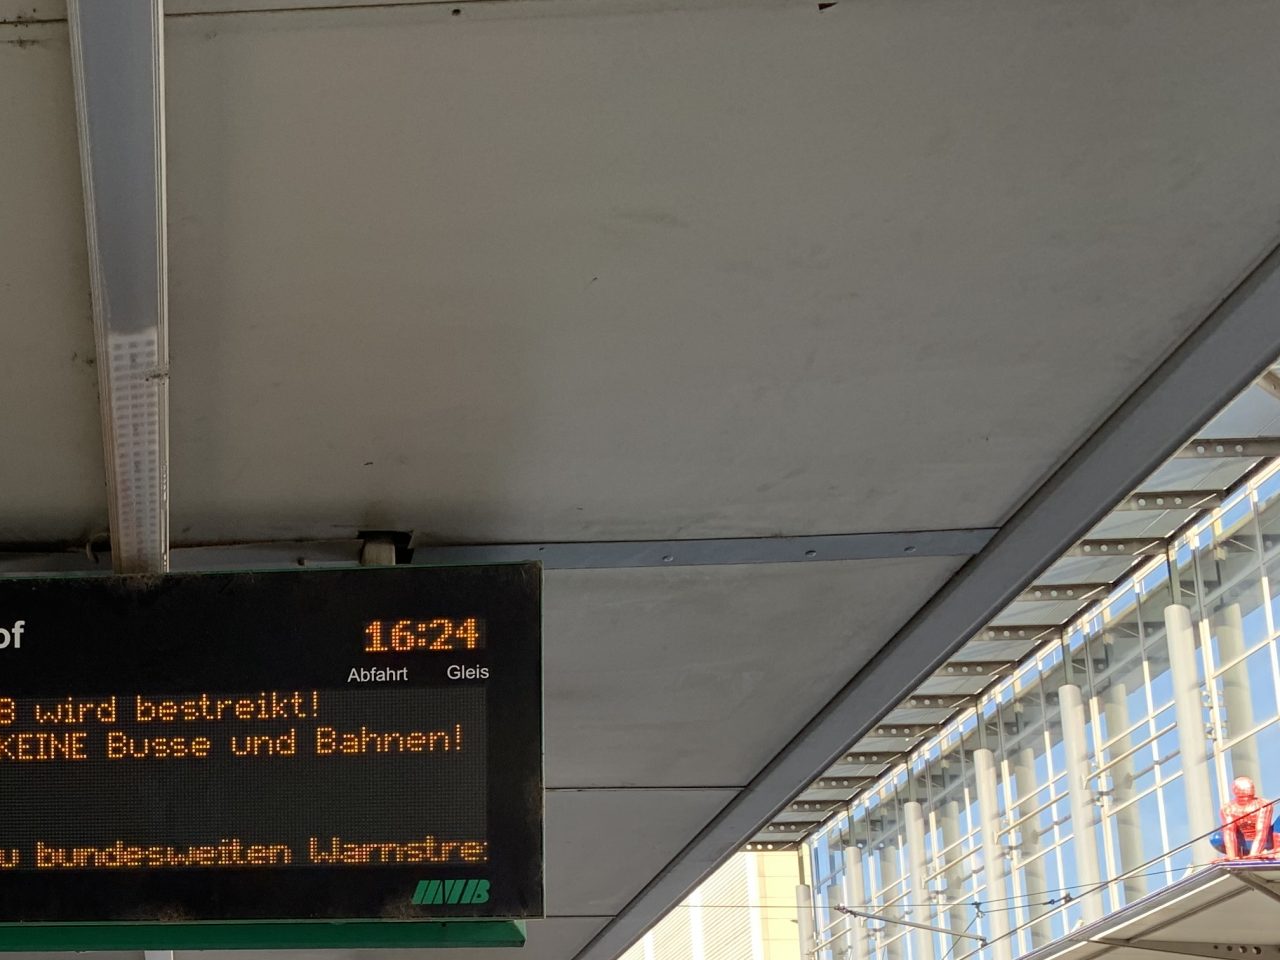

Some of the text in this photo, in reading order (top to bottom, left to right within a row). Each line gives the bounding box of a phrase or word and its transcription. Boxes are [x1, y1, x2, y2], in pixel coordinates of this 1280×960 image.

[365, 618, 479, 652] 16:24
[347, 667, 409, 682] Abfahrt
[447, 664, 490, 680] Gleis
[36, 696, 116, 723] wird
[136, 690, 318, 721] bestreikt!
[108, 730, 211, 758] Busse
[231, 727, 296, 756] und
[316, 723, 462, 754] Bahnen!
[36, 838, 293, 868] bundesweiten
